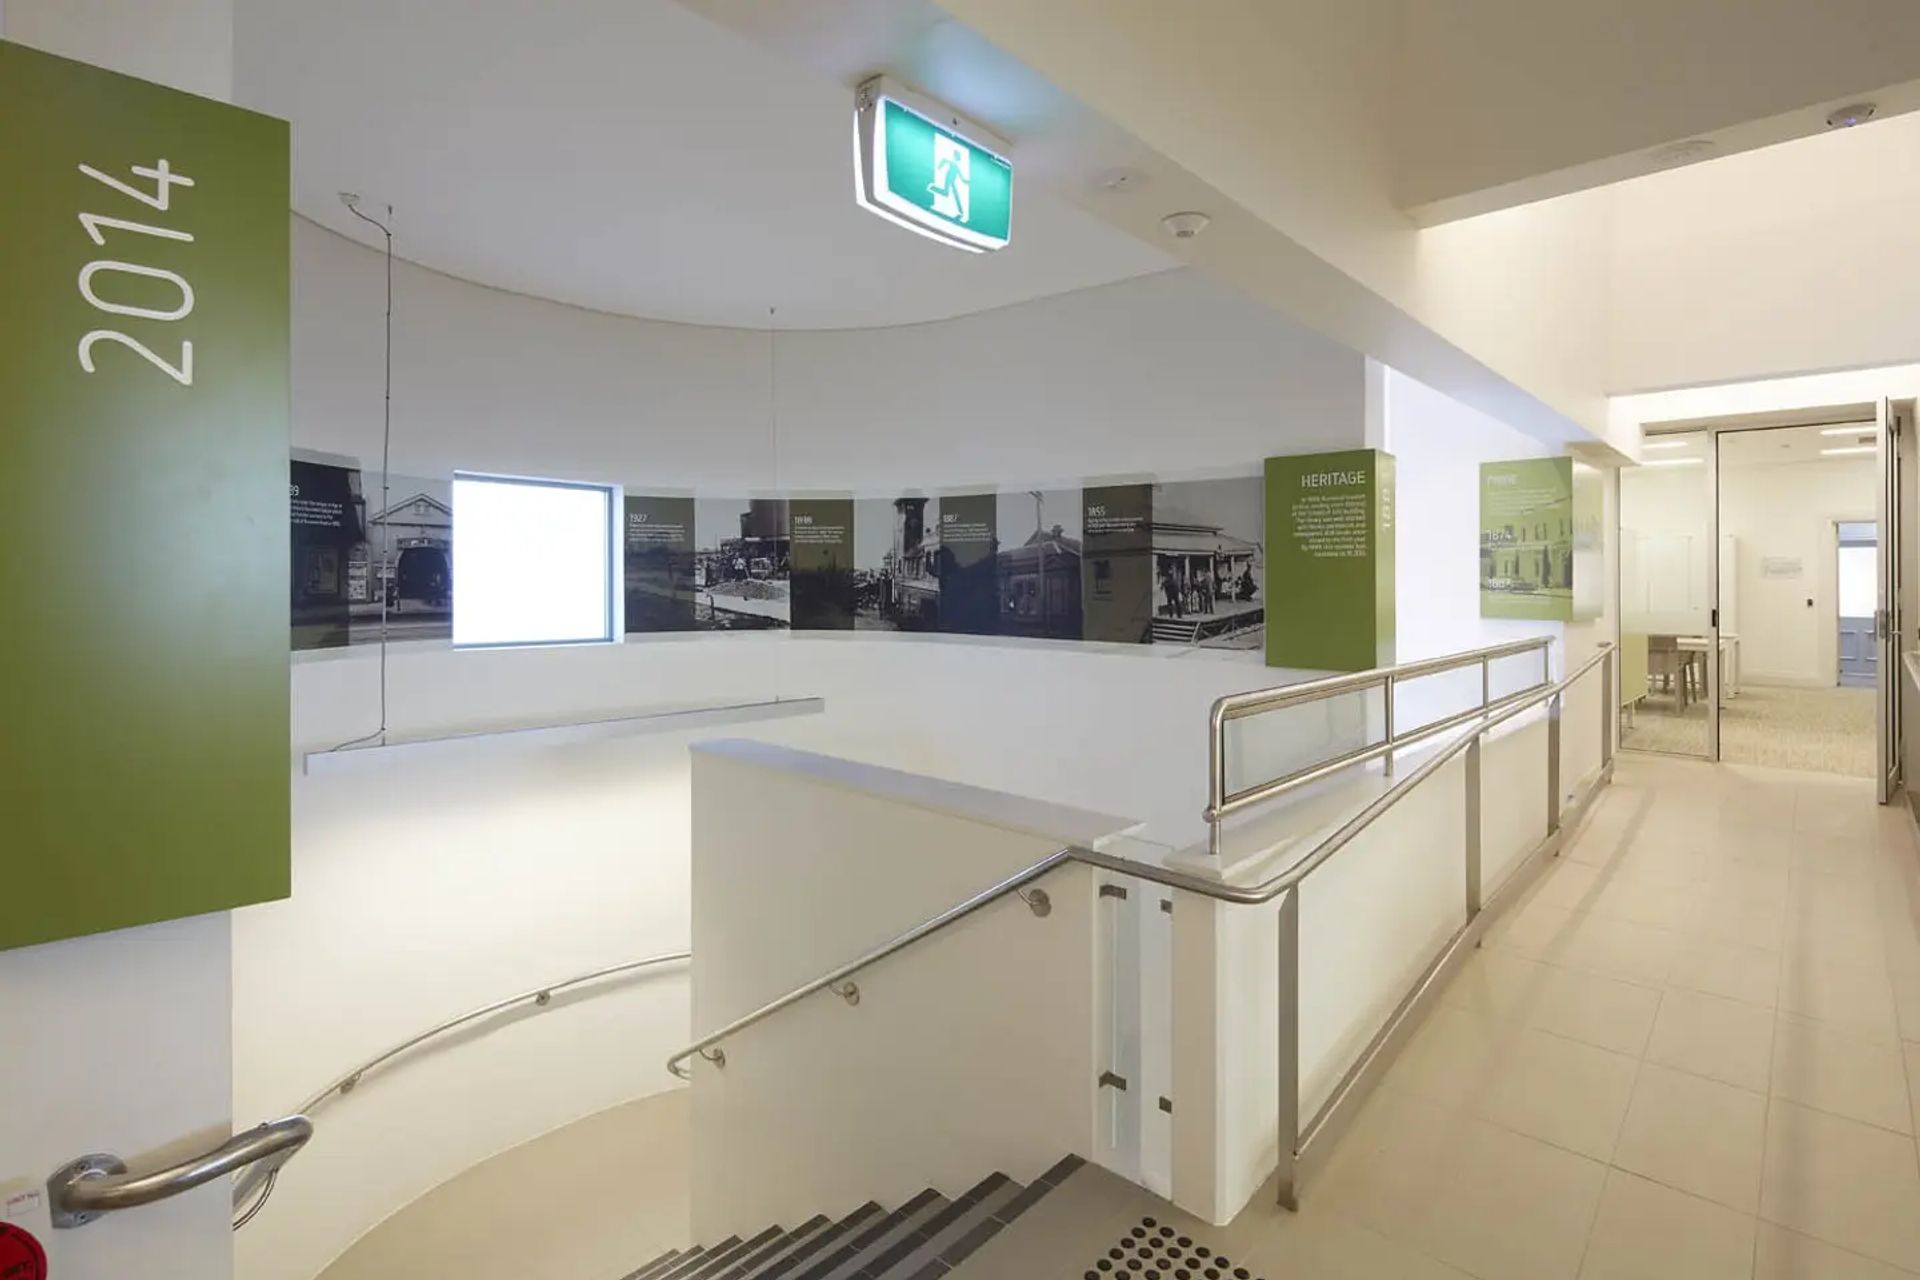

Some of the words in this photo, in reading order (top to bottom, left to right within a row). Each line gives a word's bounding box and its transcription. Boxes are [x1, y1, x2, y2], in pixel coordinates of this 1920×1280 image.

[79, 159, 194, 385] 2014
[1301, 471, 1366, 488] HERITAGE
[629, 513, 648, 523] 1927
